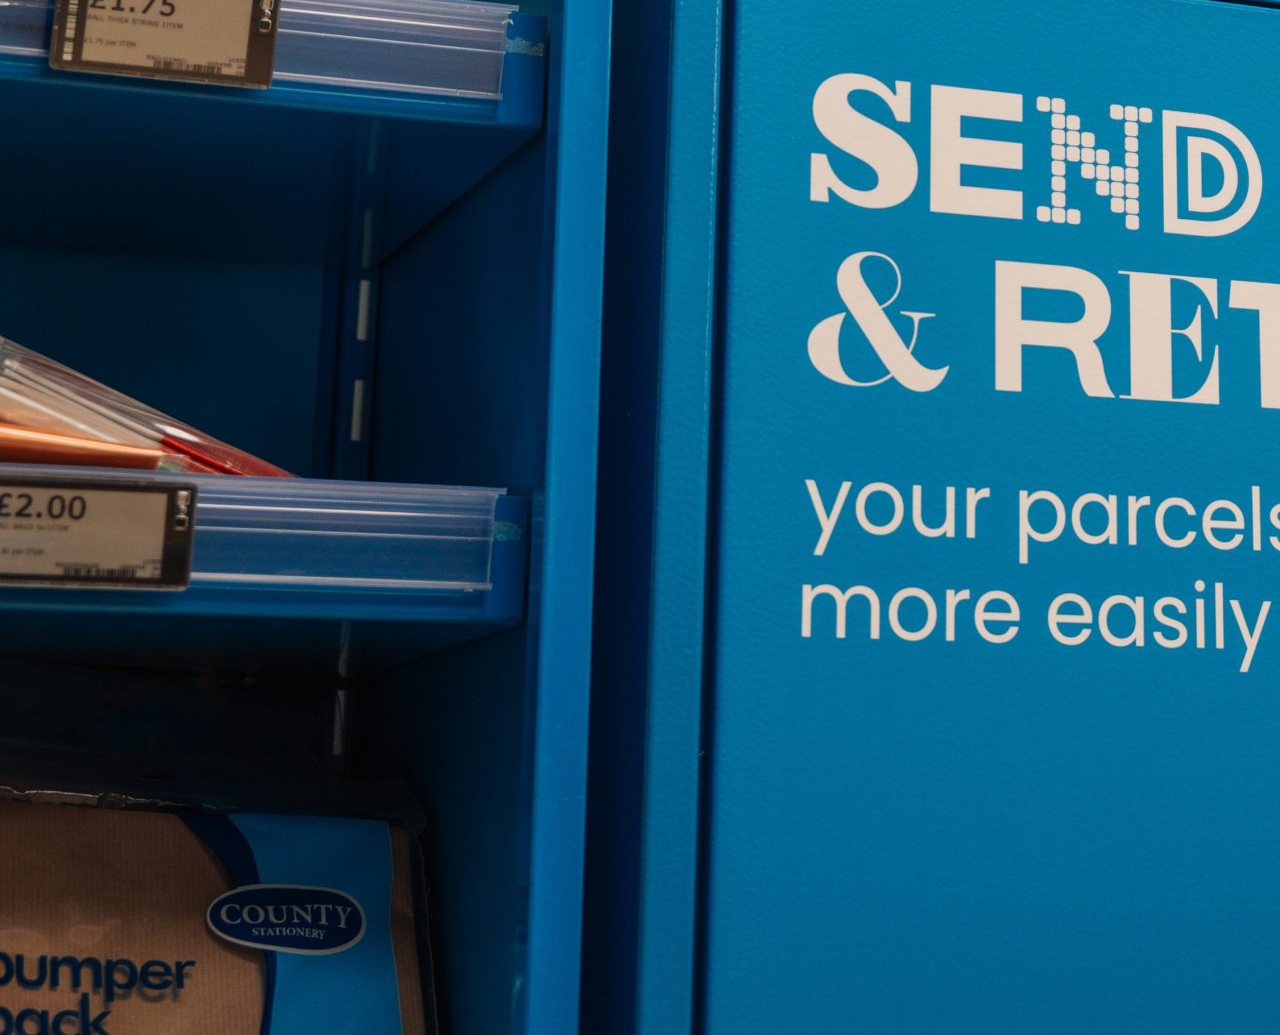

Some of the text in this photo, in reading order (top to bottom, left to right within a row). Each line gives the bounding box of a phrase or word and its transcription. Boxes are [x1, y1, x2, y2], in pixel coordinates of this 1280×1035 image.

[810, 72, 1263, 237] SEND
[808, 251, 949, 392] &
[0, 492, 87, 520] £2.00
[806, 479, 991, 556] your
[801, 584, 1020, 644] more
[1047, 579, 1272, 673] easily
[220, 902, 353, 929] COUNTY
[251, 926, 326, 940] STATIONERY
